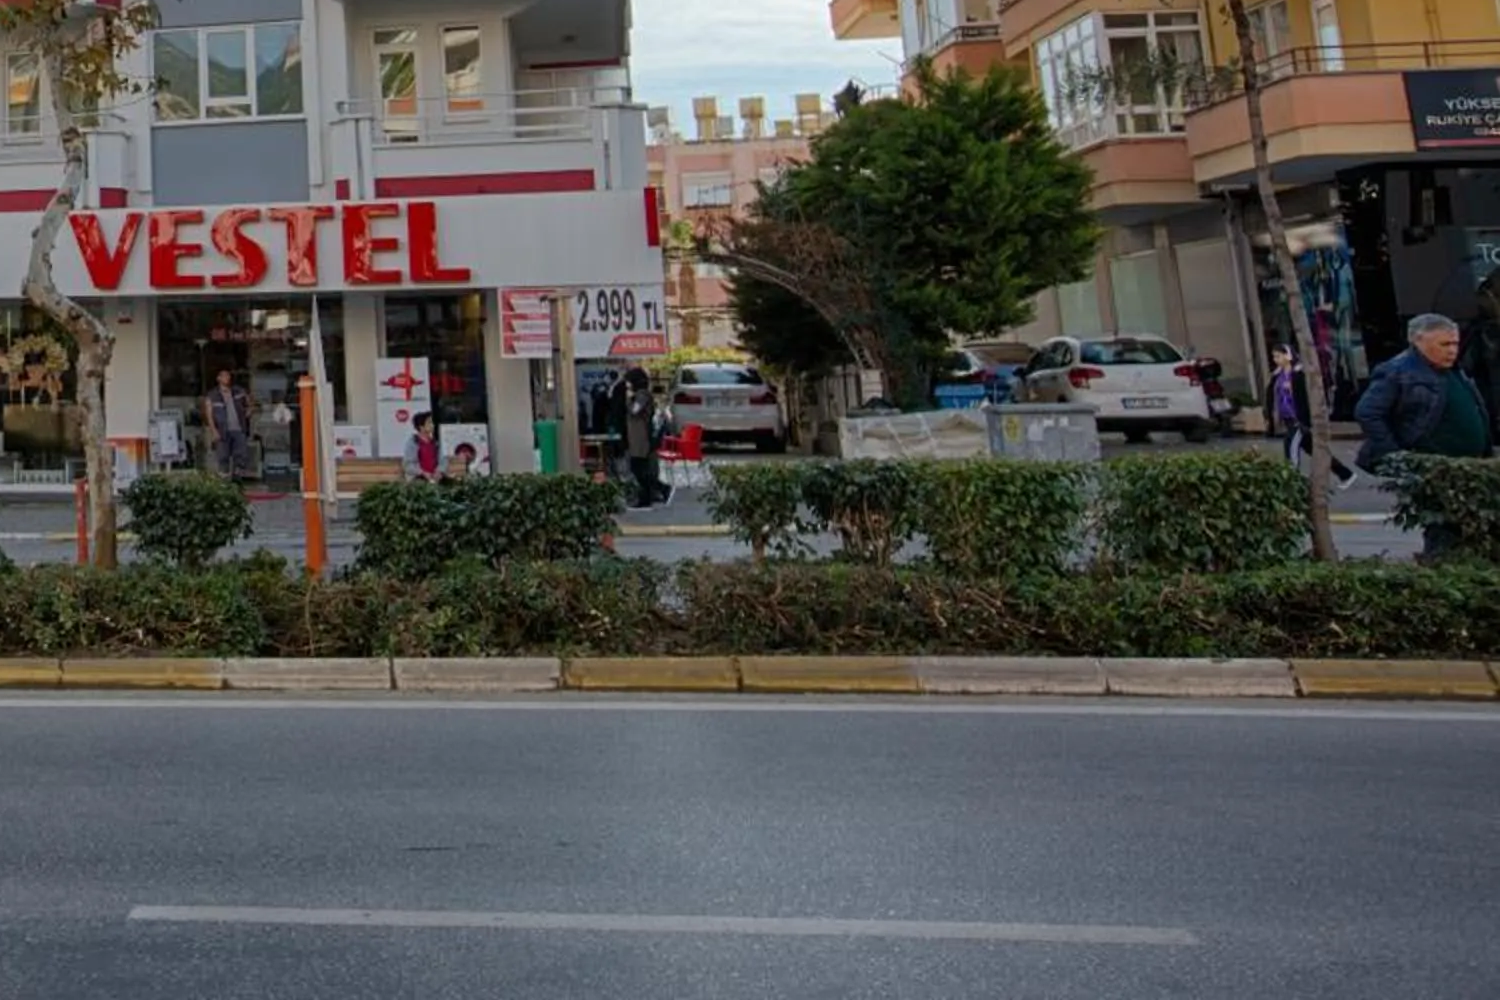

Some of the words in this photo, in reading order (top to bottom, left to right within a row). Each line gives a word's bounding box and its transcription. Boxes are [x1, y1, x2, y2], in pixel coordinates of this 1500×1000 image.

[68, 202, 471, 290] VESTEL
[577, 289, 637, 332] 2.999
[642, 301, 663, 331] TL
